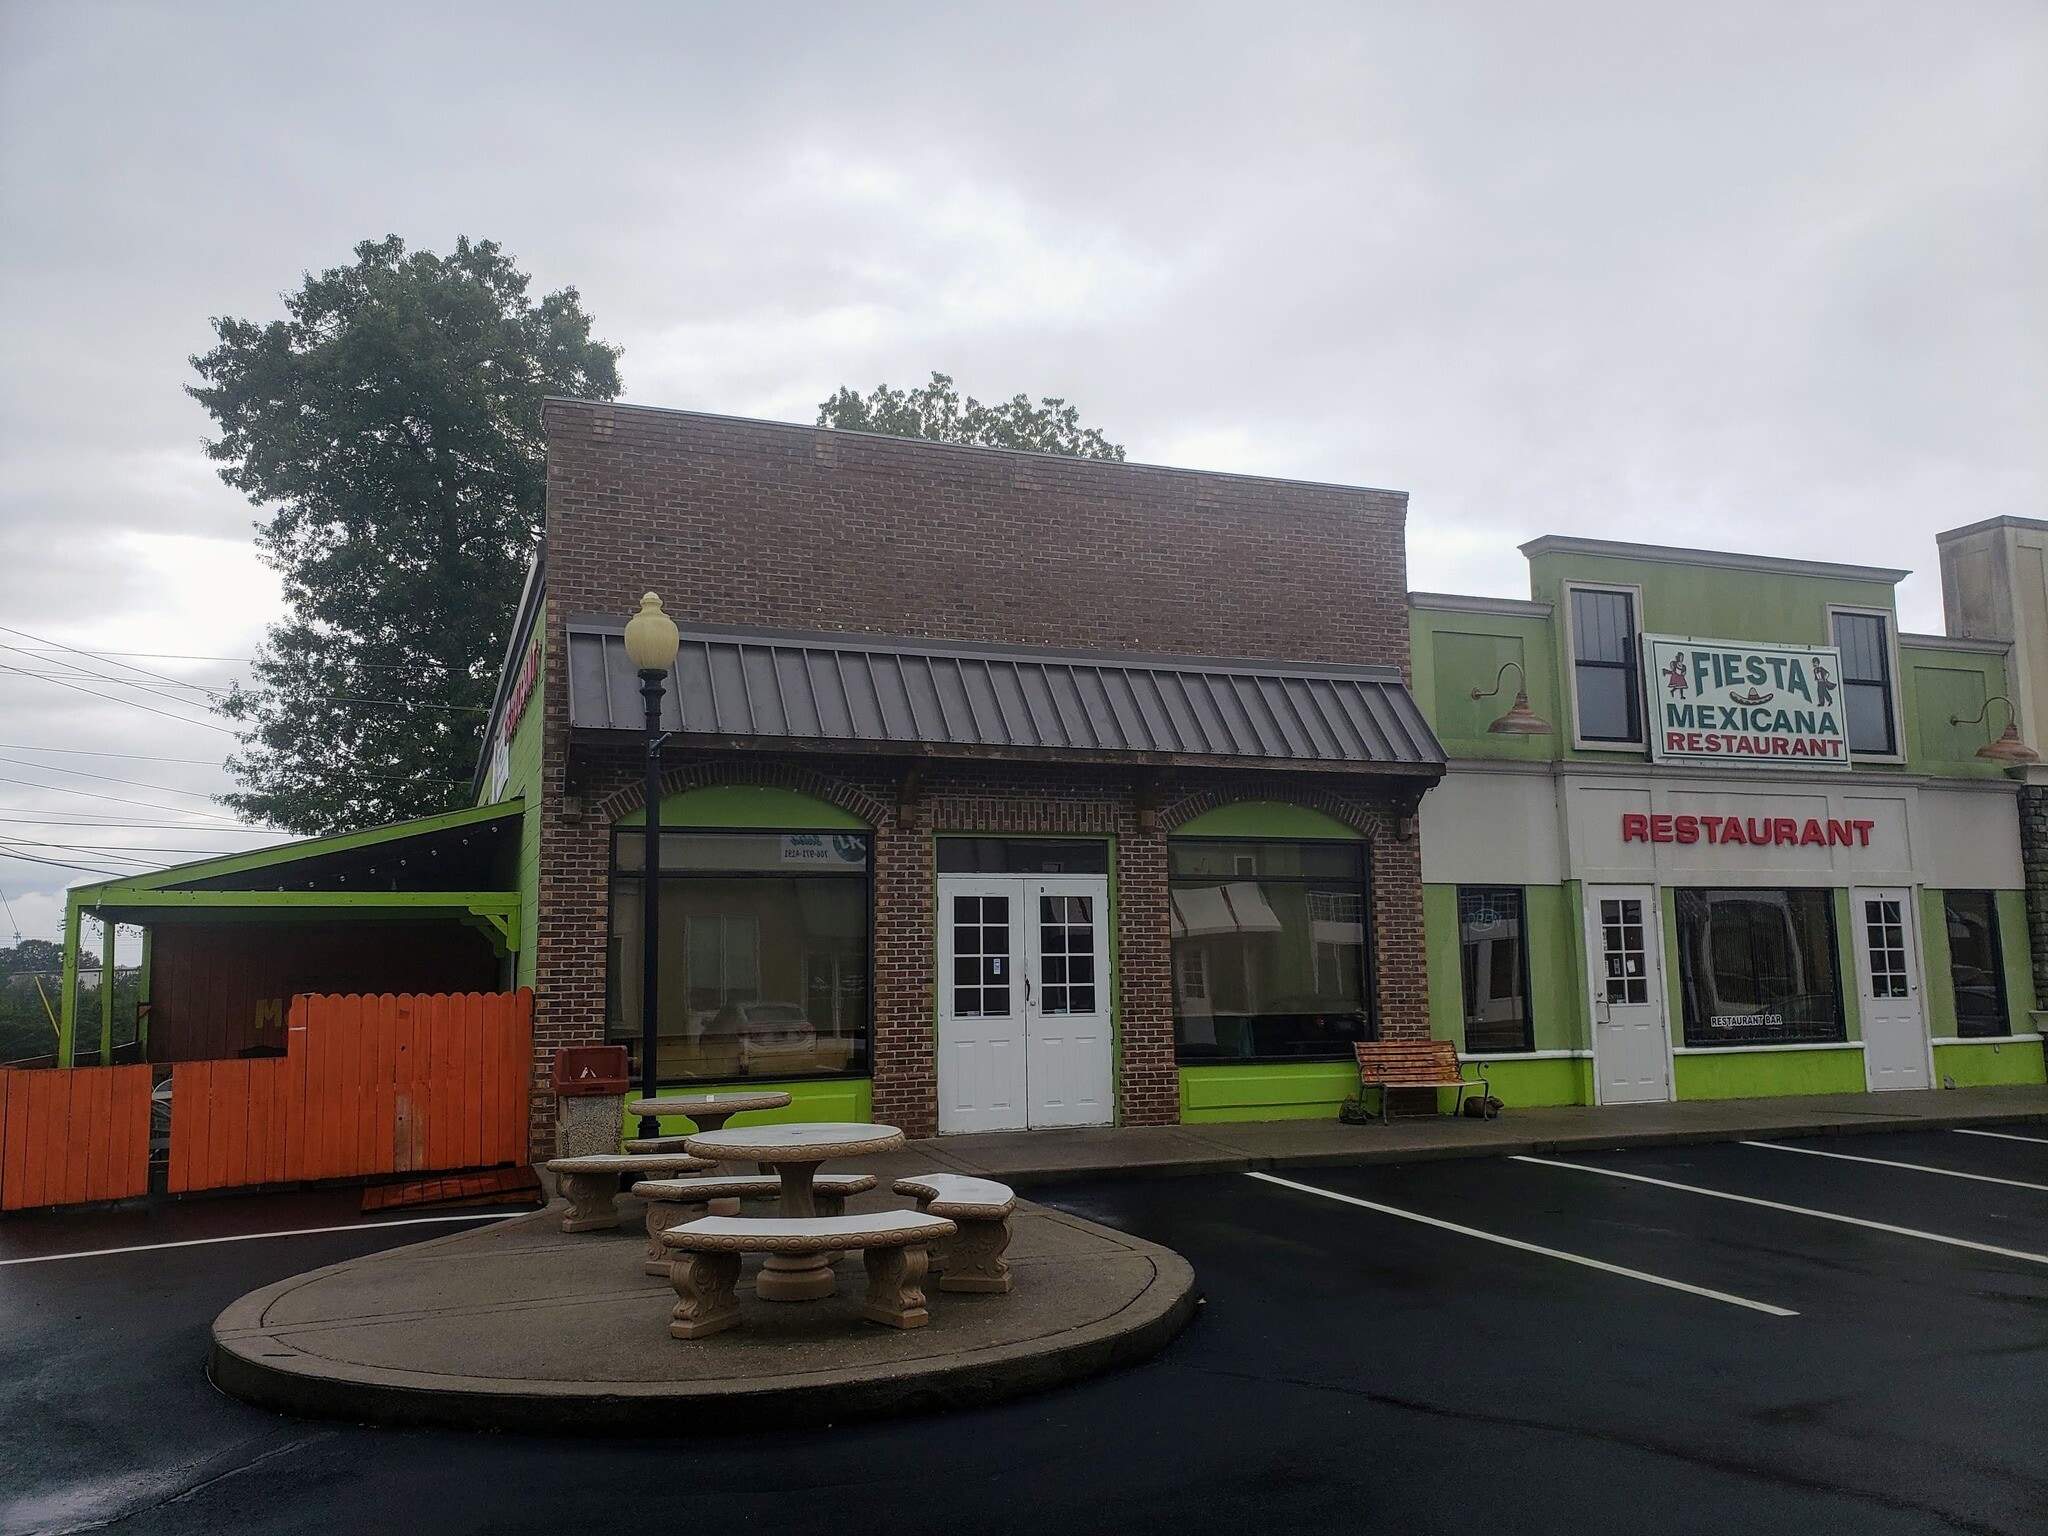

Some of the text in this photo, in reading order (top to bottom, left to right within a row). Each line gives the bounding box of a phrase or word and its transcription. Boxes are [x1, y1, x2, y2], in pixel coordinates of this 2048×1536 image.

[1691, 651, 1813, 704] FIESTA
[1666, 703, 1839, 735] MEXICANA
[1666, 732, 1843, 757] RESTAURANT
[1623, 814, 1875, 846] RESTAURANT
[1467, 912, 1502, 928] OPEN
[1711, 1014, 1783, 1027] RESTAURANT BAR
